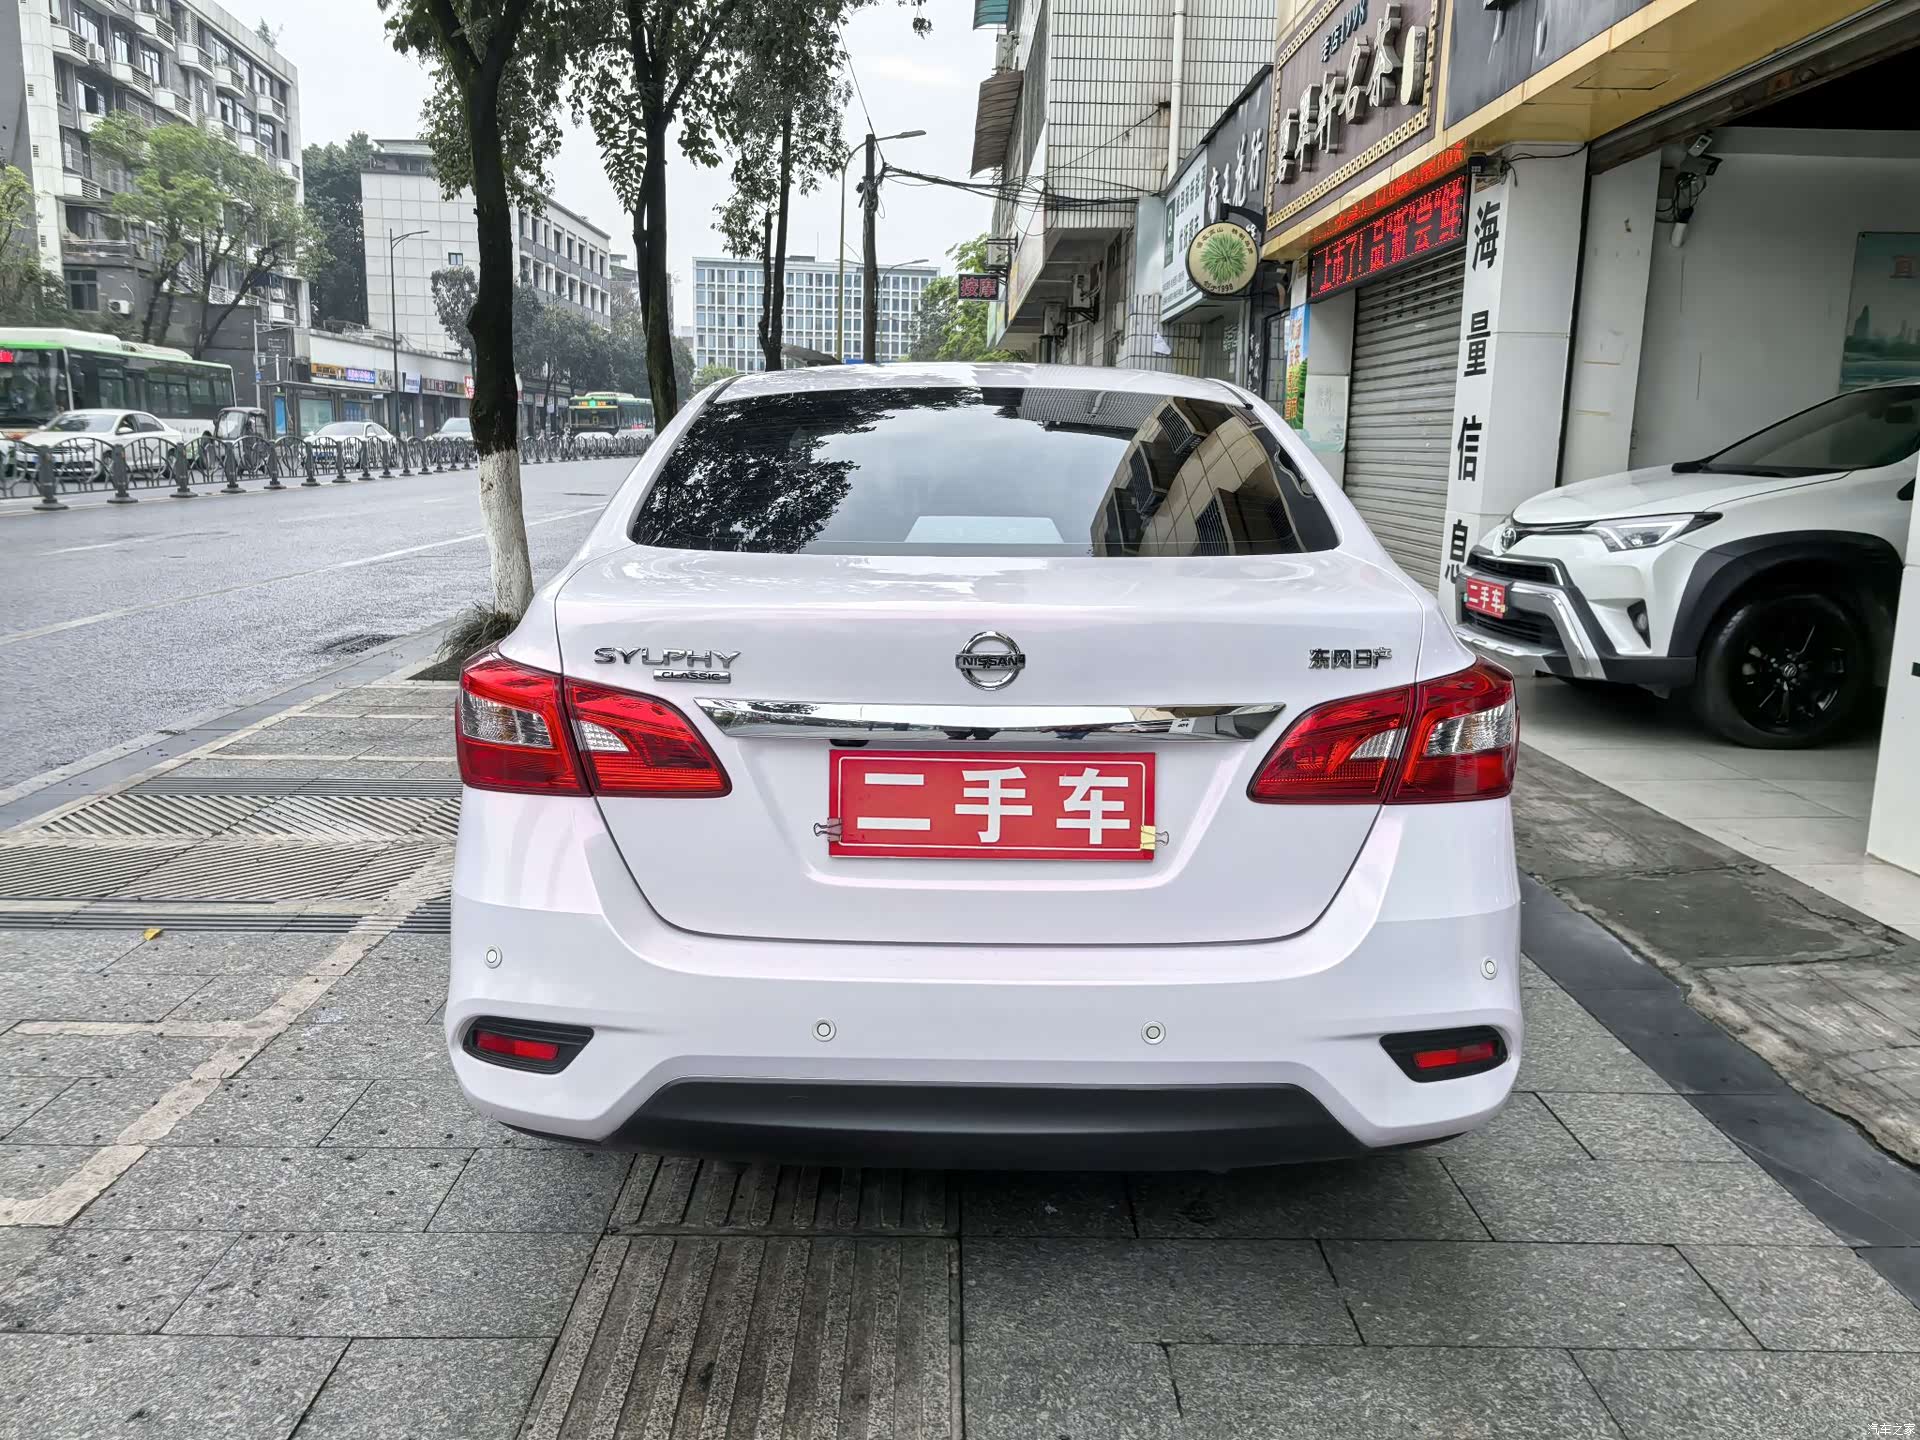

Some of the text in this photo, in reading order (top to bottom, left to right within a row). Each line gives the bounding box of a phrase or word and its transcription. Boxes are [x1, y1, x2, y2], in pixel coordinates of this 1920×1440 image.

[961, 277, 997, 297] 按摩
[1468, 584, 1502, 613] 二手车
[594, 647, 742, 669] SYLPHY
[962, 657, 1018, 667] NISSAN
[1308, 647, 1392, 669] 东风日产
[661, 671, 721, 681] CLASSIC
[857, 766, 1131, 845] 二手车
